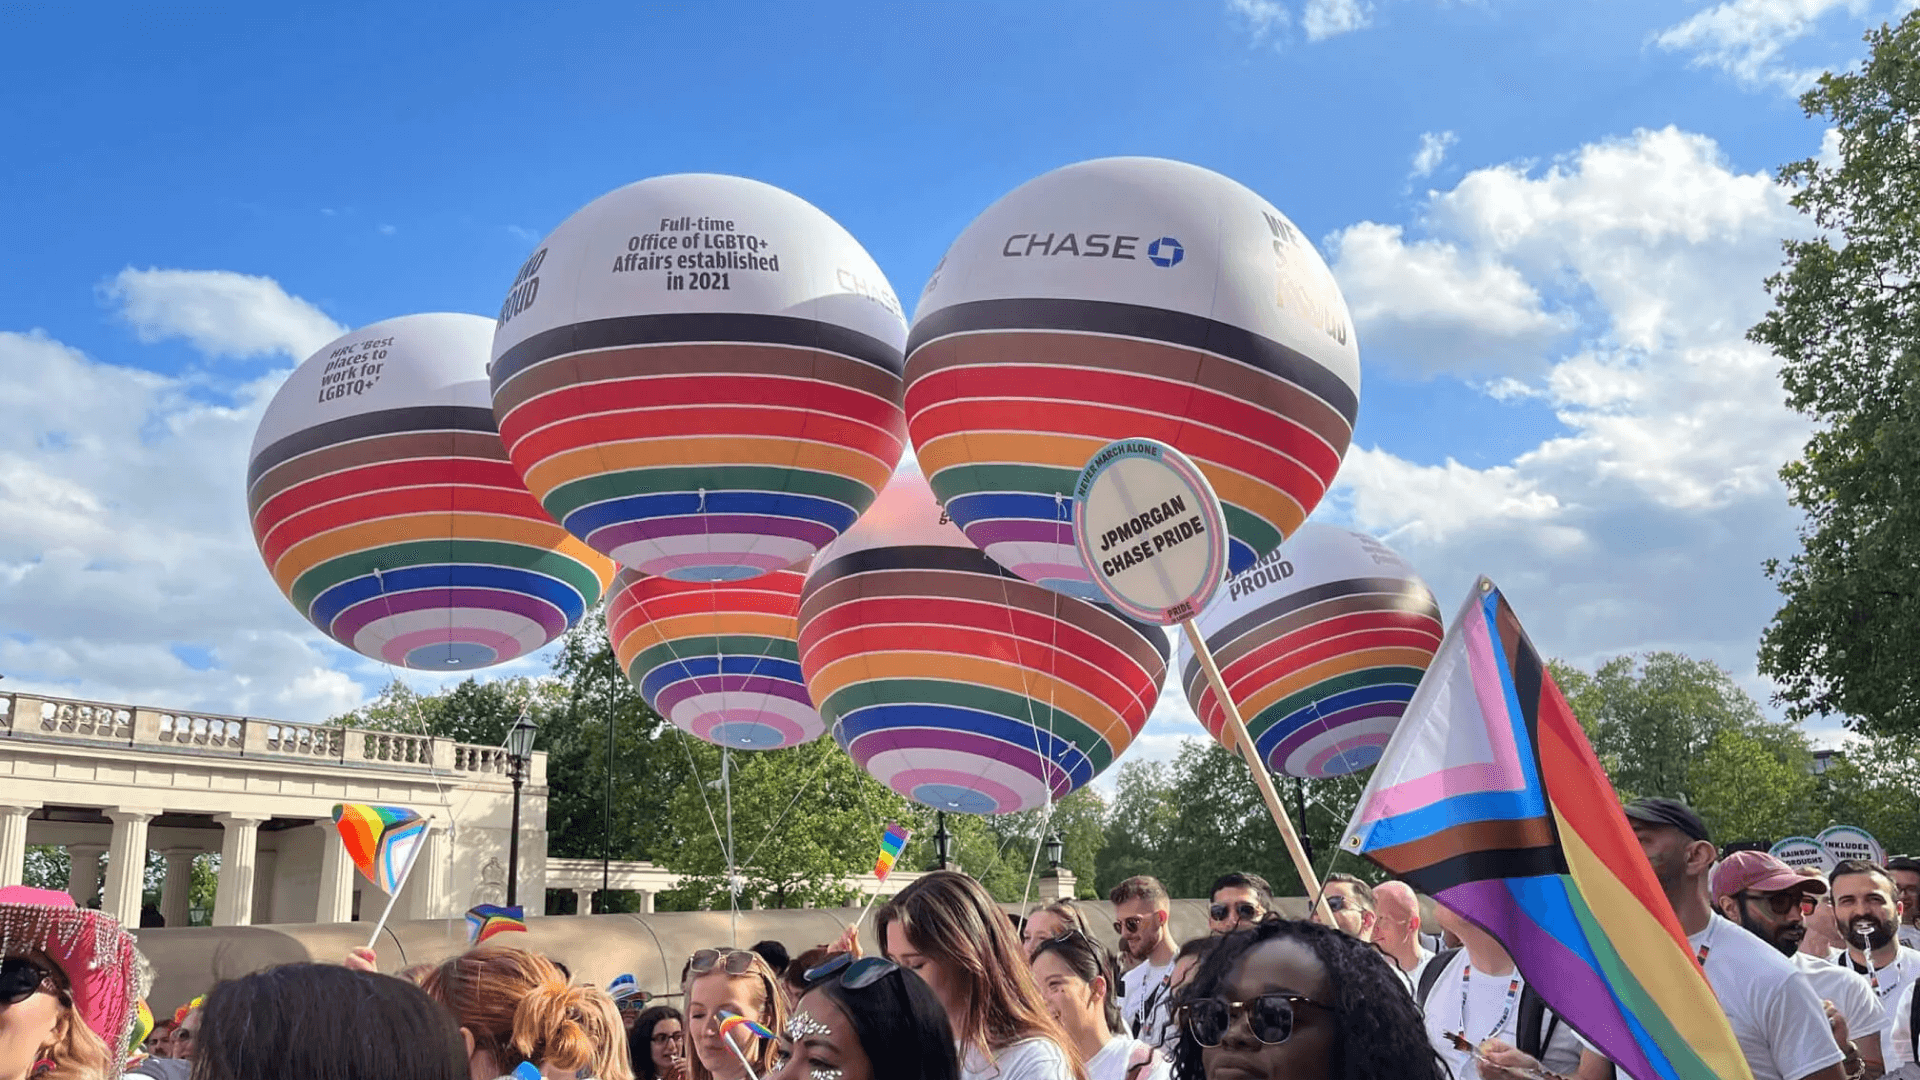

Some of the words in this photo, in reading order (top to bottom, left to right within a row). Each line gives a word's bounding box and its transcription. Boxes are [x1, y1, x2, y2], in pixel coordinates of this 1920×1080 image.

[660, 217, 735, 232] Full-time
[628, 234, 678, 251] Office
[682, 233, 700, 249] of
[704, 234, 768, 253] LGBTQ+
[1002, 233, 1140, 260] CHASE
[612, 252, 673, 273] Affairs
[677, 251, 780, 272] established
[667, 271, 684, 290] in
[689, 272, 731, 290] 2021
[330, 343, 358, 359] HRC
[324, 352, 369, 375] places
[372, 350, 388, 360] to
[321, 366, 358, 387] work
[361, 363, 384, 377] for
[1078, 464, 1098, 497] NEVER
[1094, 444, 1125, 469] MARCH
[1126, 443, 1157, 456] ALONE
[1101, 494, 1187, 552] JPMORGAN
[1102, 540, 1155, 577] CHASE
[1152, 515, 1205, 553] PRIDE
[1229, 560, 1295, 602] PROUD
[1167, 601, 1192, 619] PRIDE
[1780, 848, 1818, 858] RAINBOW
[1784, 856, 1823, 866] OROUGHS
